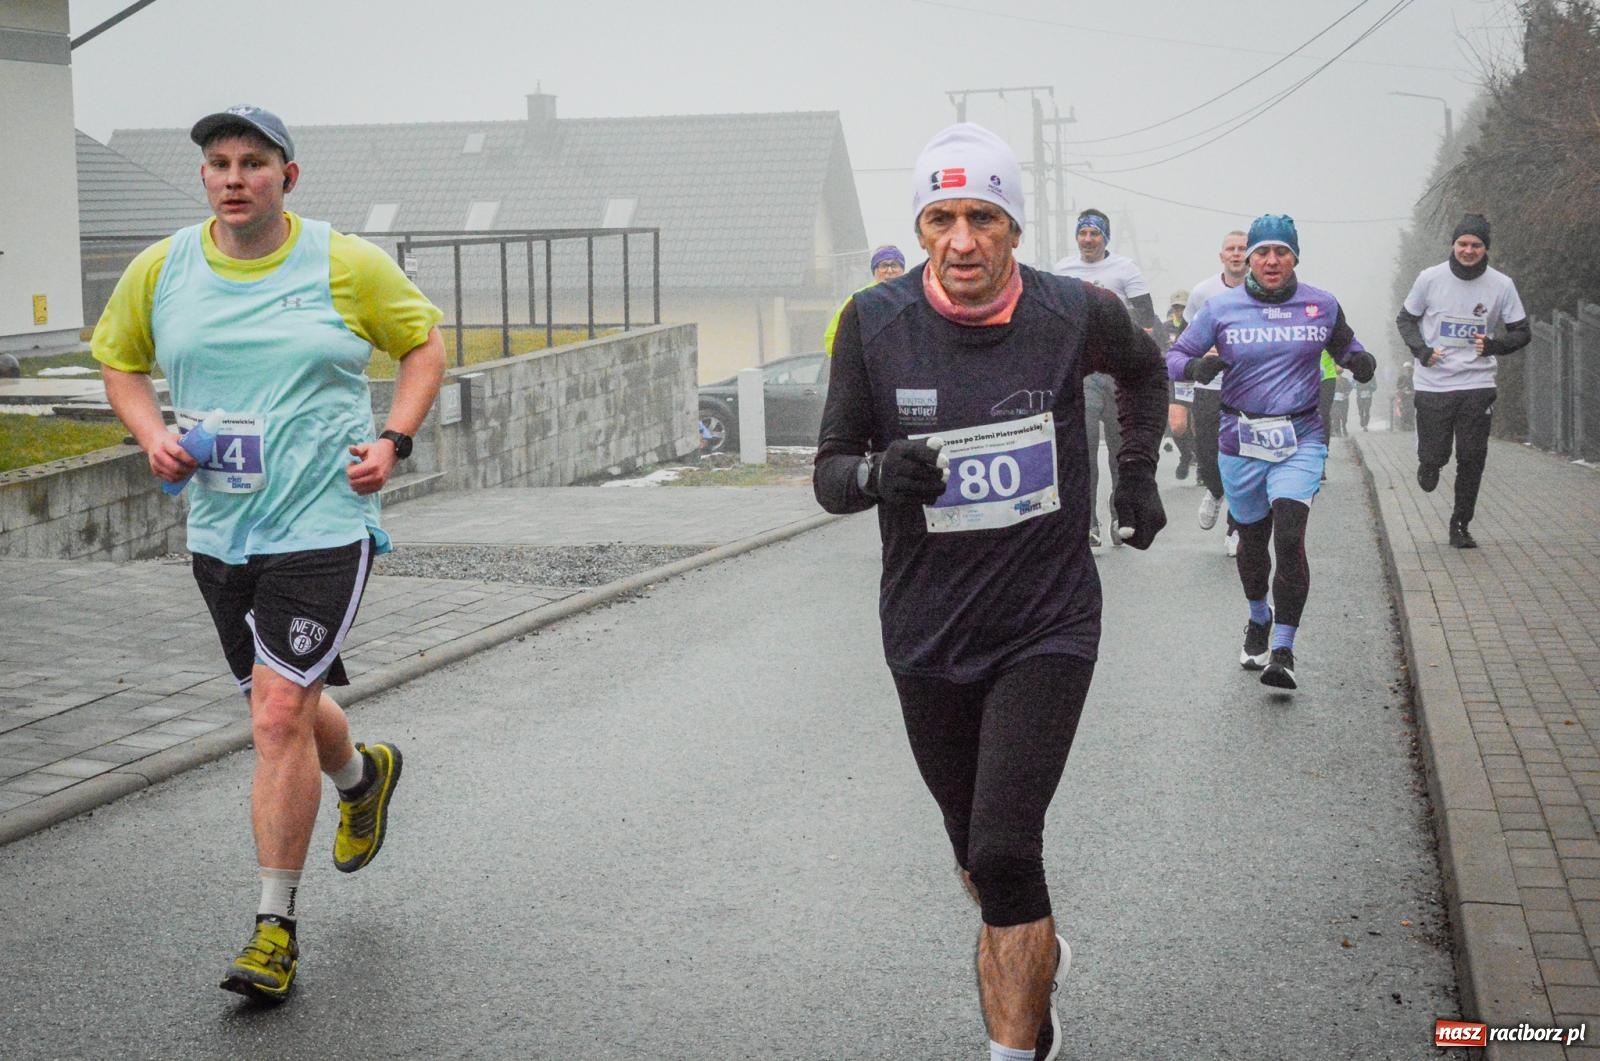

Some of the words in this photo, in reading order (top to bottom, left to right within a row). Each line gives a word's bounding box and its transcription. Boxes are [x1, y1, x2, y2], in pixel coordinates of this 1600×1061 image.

[1226, 326, 1328, 344] RUNNERS
[964, 436, 974, 444] po
[974, 433, 995, 441] Ziemi
[958, 455, 1021, 500] 80
[292, 620, 324, 641] NETS
